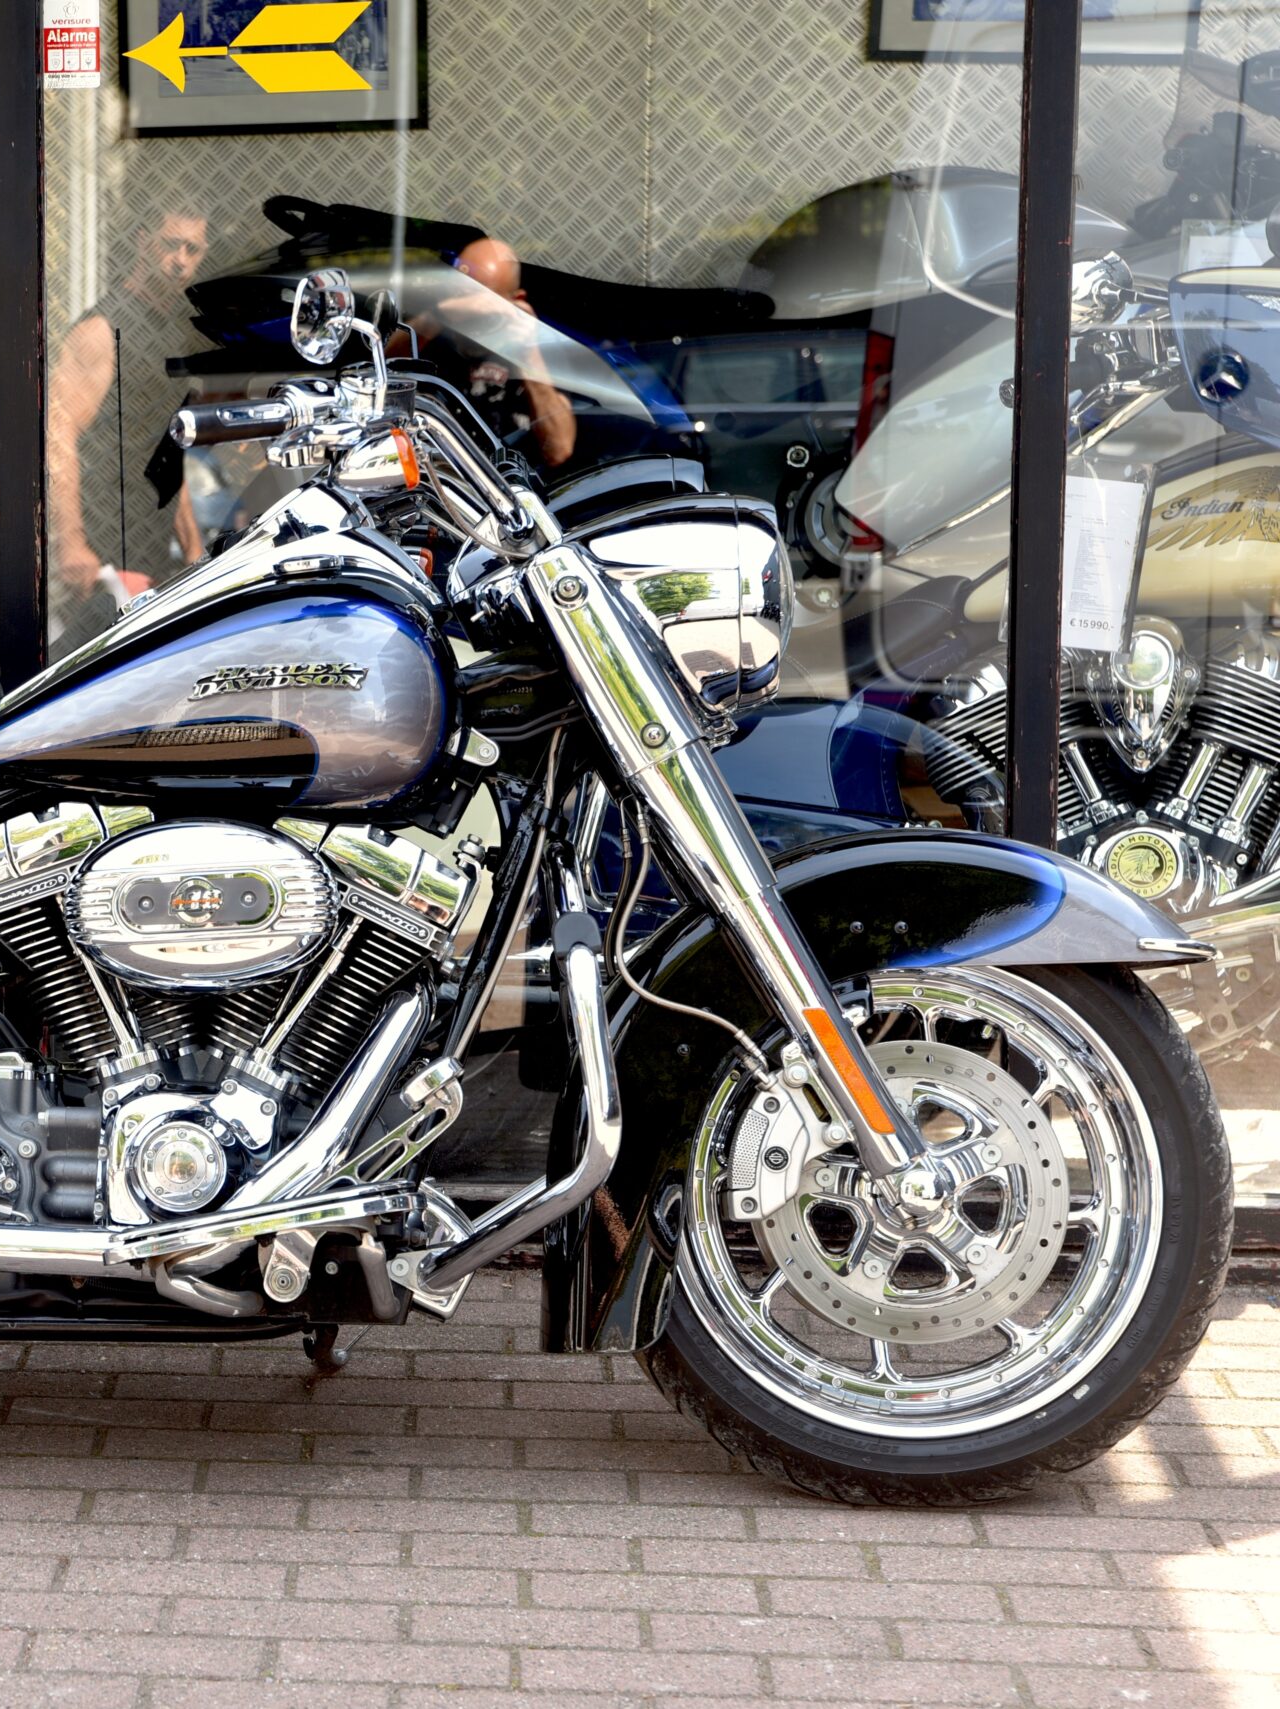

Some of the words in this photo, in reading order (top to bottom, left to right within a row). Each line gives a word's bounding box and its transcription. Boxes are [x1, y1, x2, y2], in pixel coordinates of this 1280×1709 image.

[47, 29, 97, 43] Alarme
[1162, 498, 1244, 521] Indian
[187, 673, 364, 701] DAVIDSON
[1128, 835, 1174, 883] MOTORCYCLE
